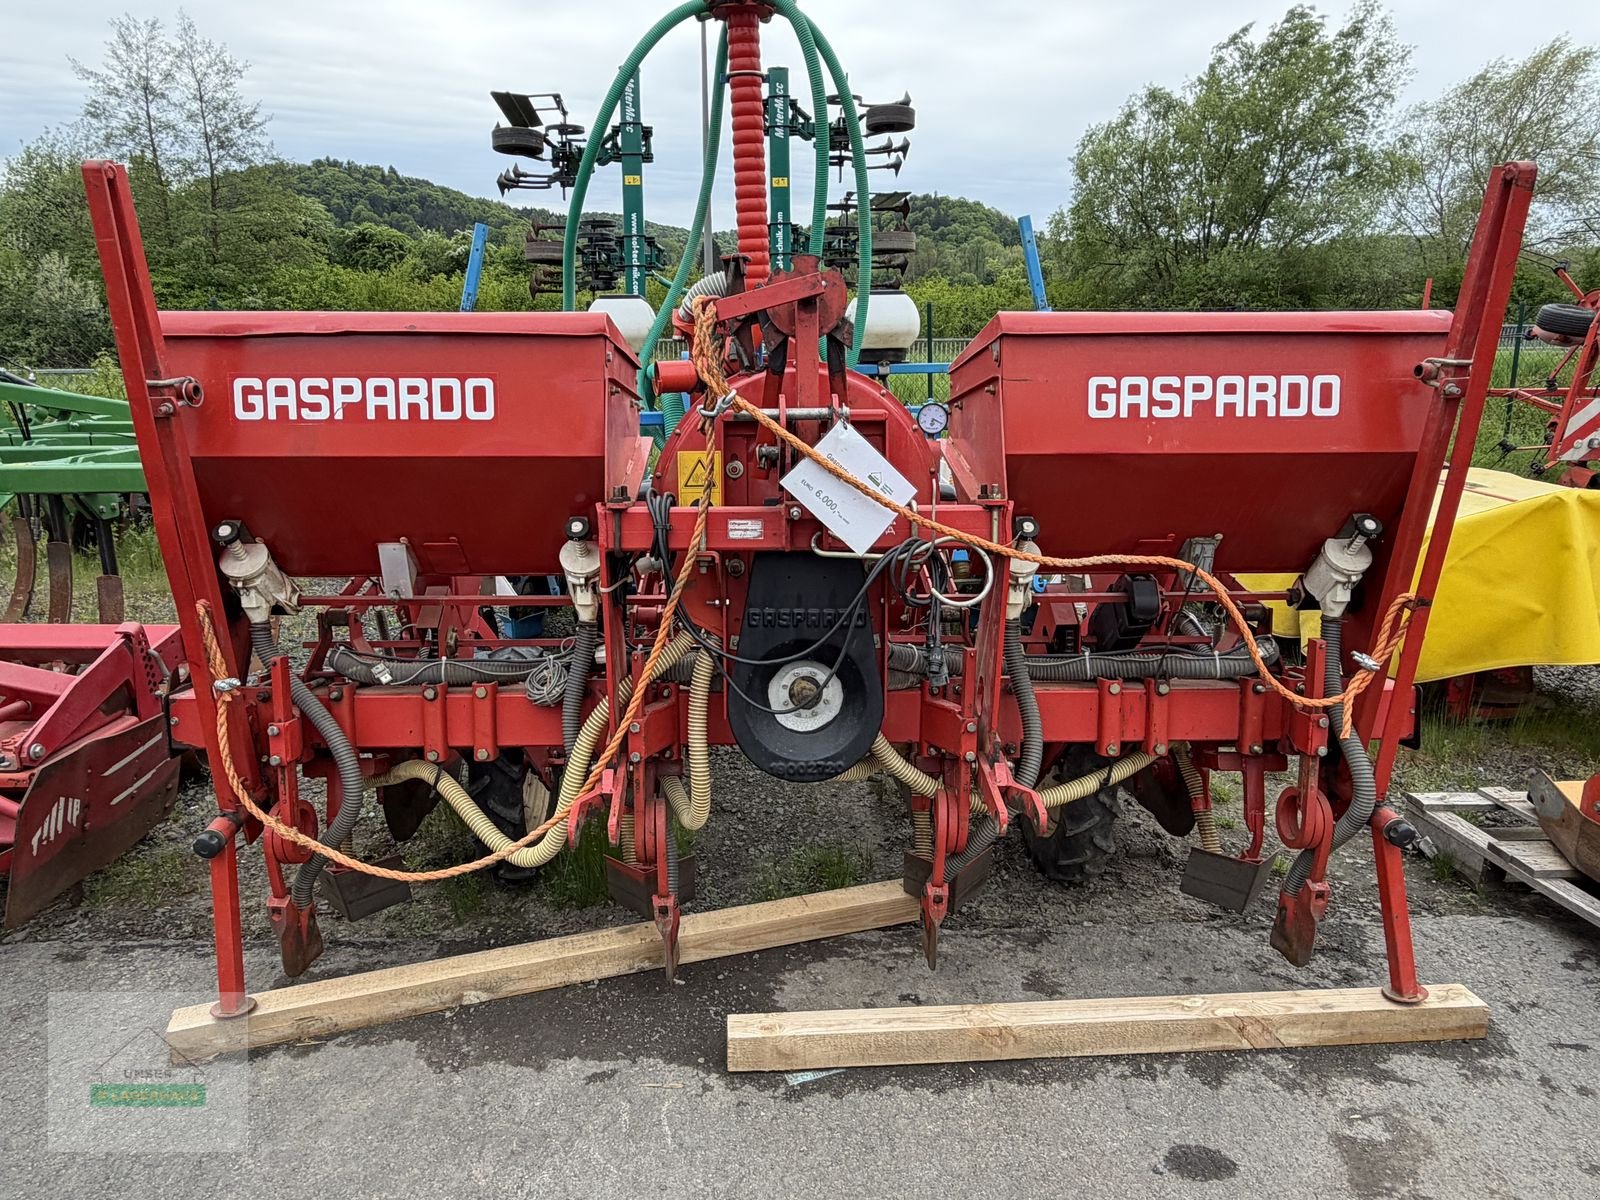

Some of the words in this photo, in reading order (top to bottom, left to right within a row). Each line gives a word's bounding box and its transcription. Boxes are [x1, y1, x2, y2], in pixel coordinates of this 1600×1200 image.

[233, 377, 495, 421] GASPARDO
[1087, 374, 1342, 419] GASPARDO
[748, 607, 867, 629] GASPARDO
